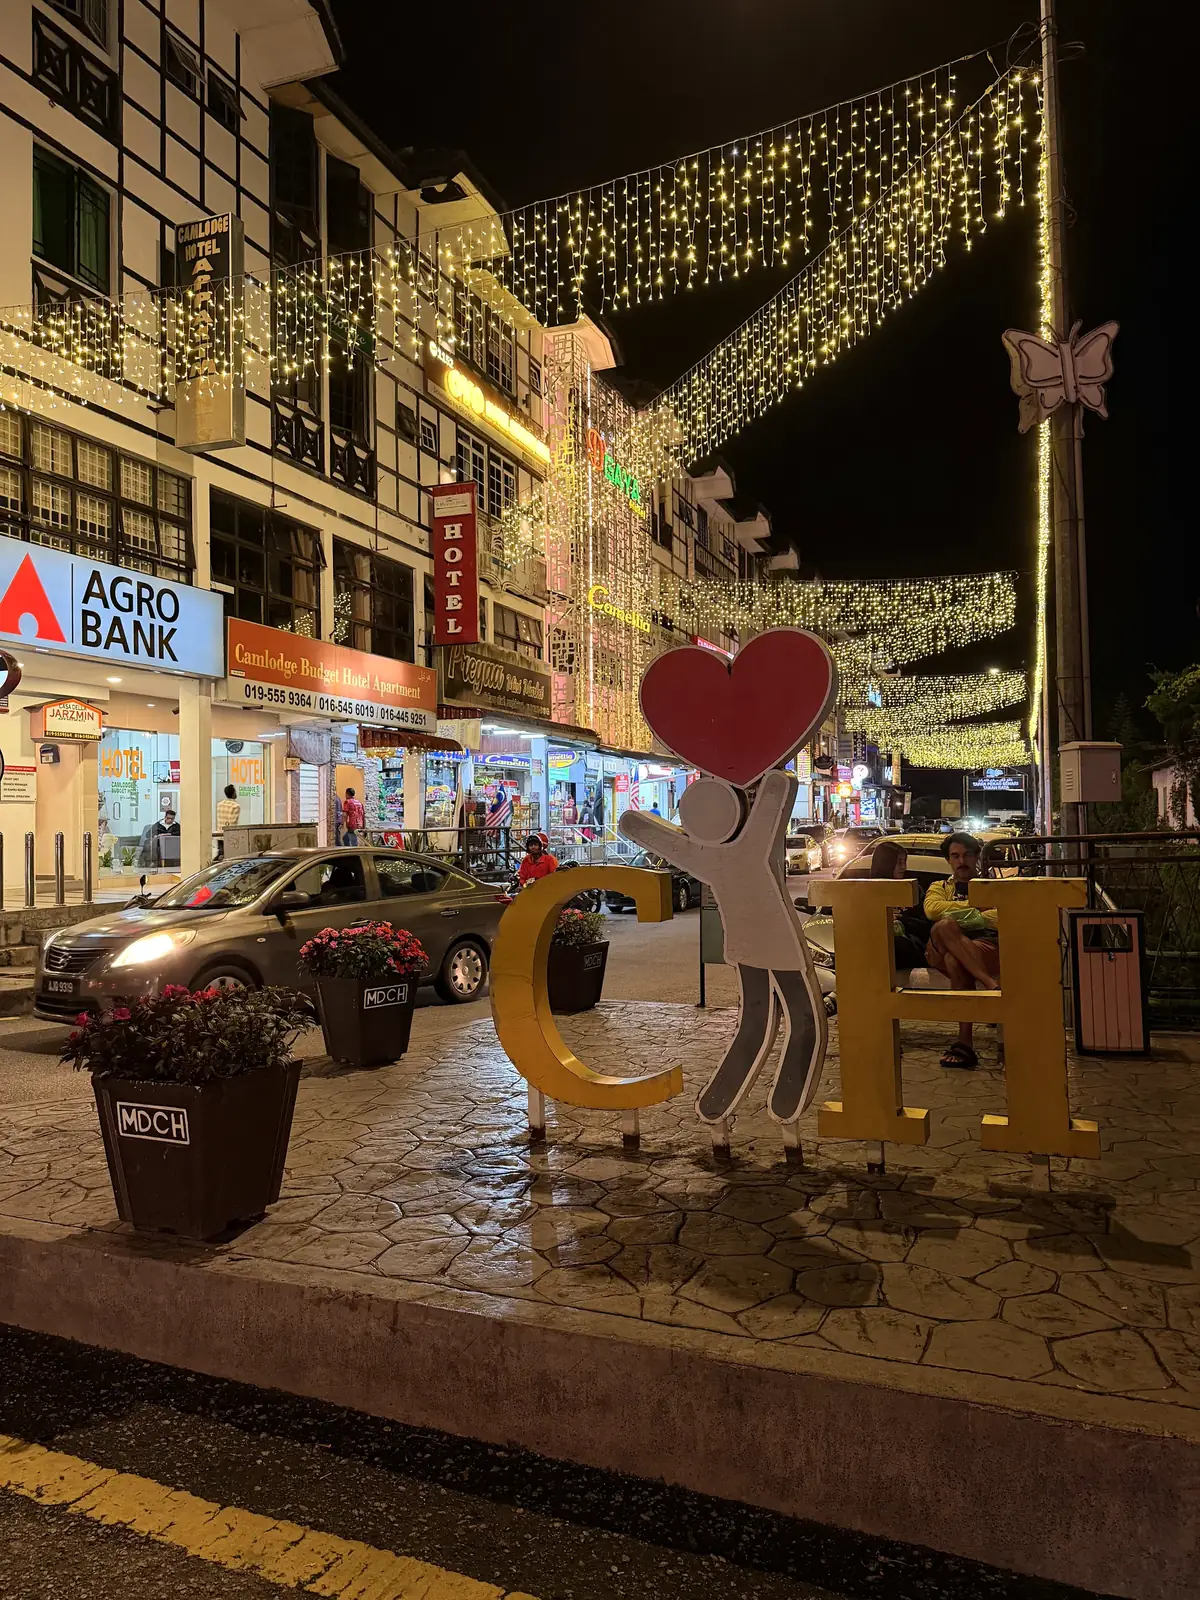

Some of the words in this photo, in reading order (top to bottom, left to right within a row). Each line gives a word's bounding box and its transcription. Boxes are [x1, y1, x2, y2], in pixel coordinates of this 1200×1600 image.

[177, 215, 229, 243] CAMLODGE
[184, 238, 221, 262] HOTEL
[604, 452, 641, 506] GAYA
[81, 569, 181, 623] AGRO
[443, 522, 464, 634] HOTEL
[587, 585, 651, 633] Camellia
[80, 608, 179, 662] BANK
[235, 643, 298, 678] Camlodge
[300, 657, 340, 687] Budget
[342, 667, 371, 689] Hotel
[372, 675, 422, 700] Apartment
[49, 708, 95, 721] JARZMIN
[244, 683, 286, 705] 019-555
[288, 691, 312, 709] 9364
[319, 696, 353, 716] 016-545
[355, 702, 375, 718] 6019
[380, 706, 409, 724] 016-445
[410, 713, 427, 726] 9251
[101, 748, 147, 780] HOTEL
[231, 757, 266, 784] HOTEL
[366, 987, 406, 1006] MDCH
[121, 1108, 186, 1139] MDCH
